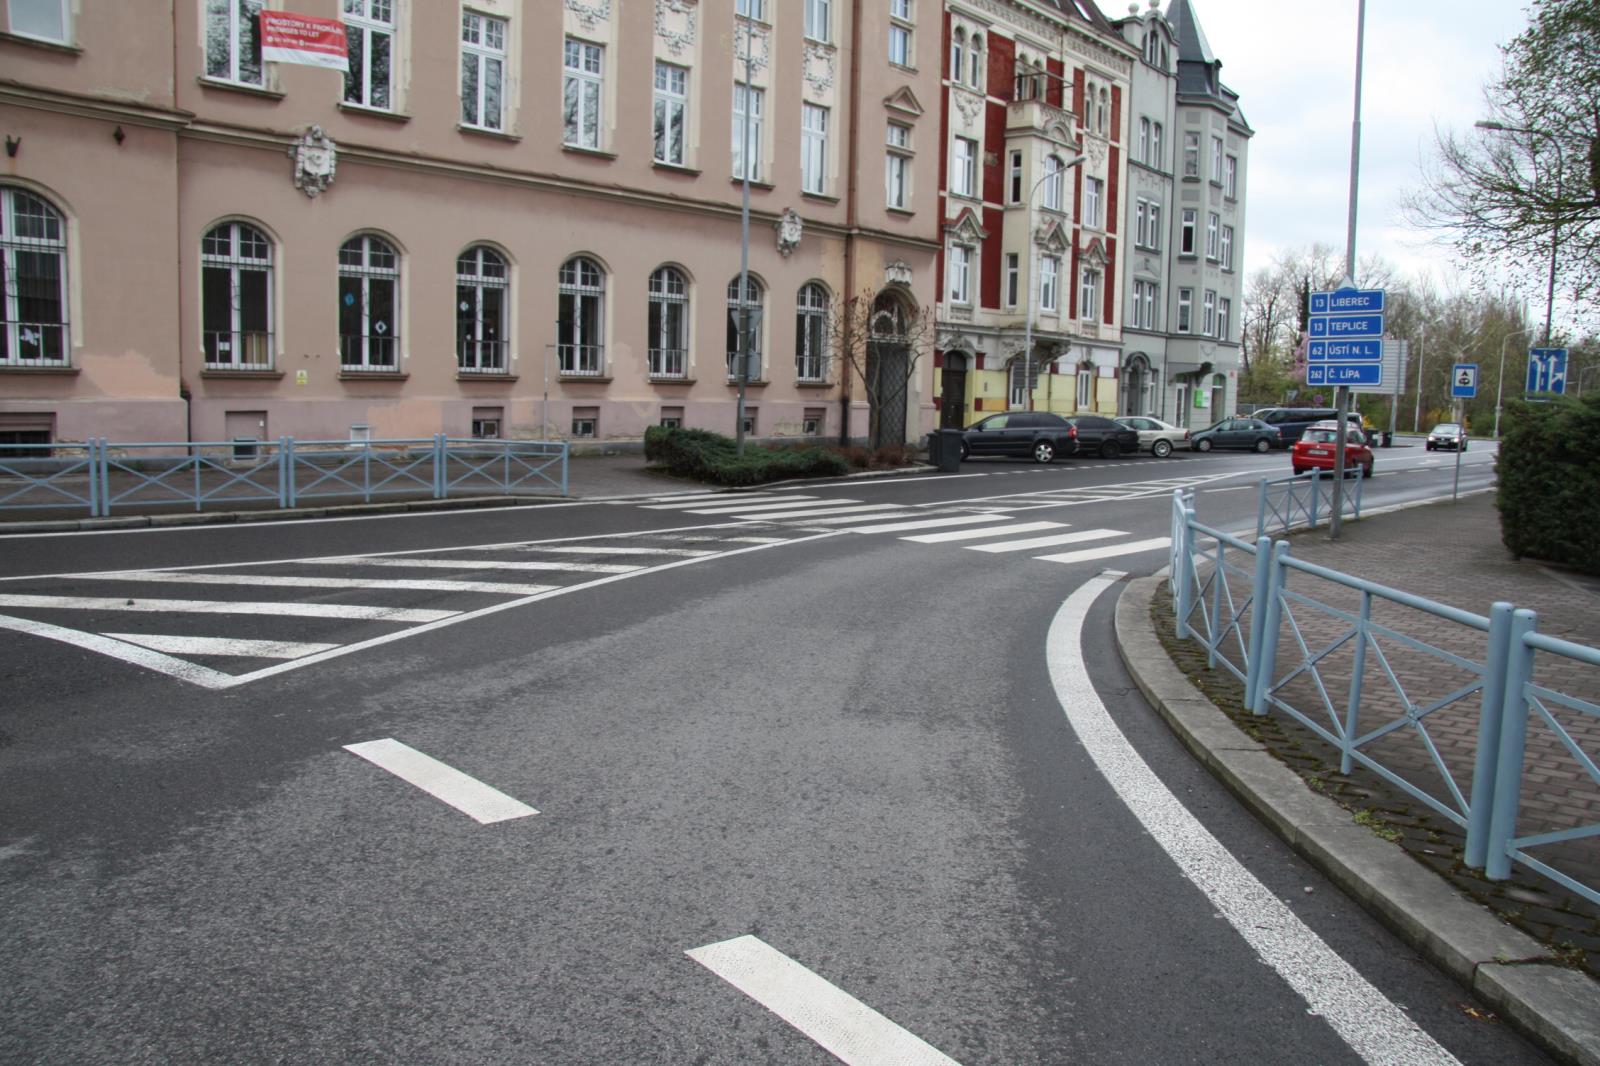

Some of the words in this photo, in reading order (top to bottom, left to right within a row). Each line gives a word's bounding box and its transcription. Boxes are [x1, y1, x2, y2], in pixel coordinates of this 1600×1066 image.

[1315, 299, 1324, 308] 13
[1331, 297, 1370, 307] LIBEREC
[1314, 322, 1323, 331] 13
[1330, 321, 1368, 331] TEPLICE
[1312, 346, 1323, 355] 62
[1328, 344, 1350, 355] ÚSTÍ
[1311, 370, 1322, 379] 262
[1340, 368, 1360, 379] LÍPA
